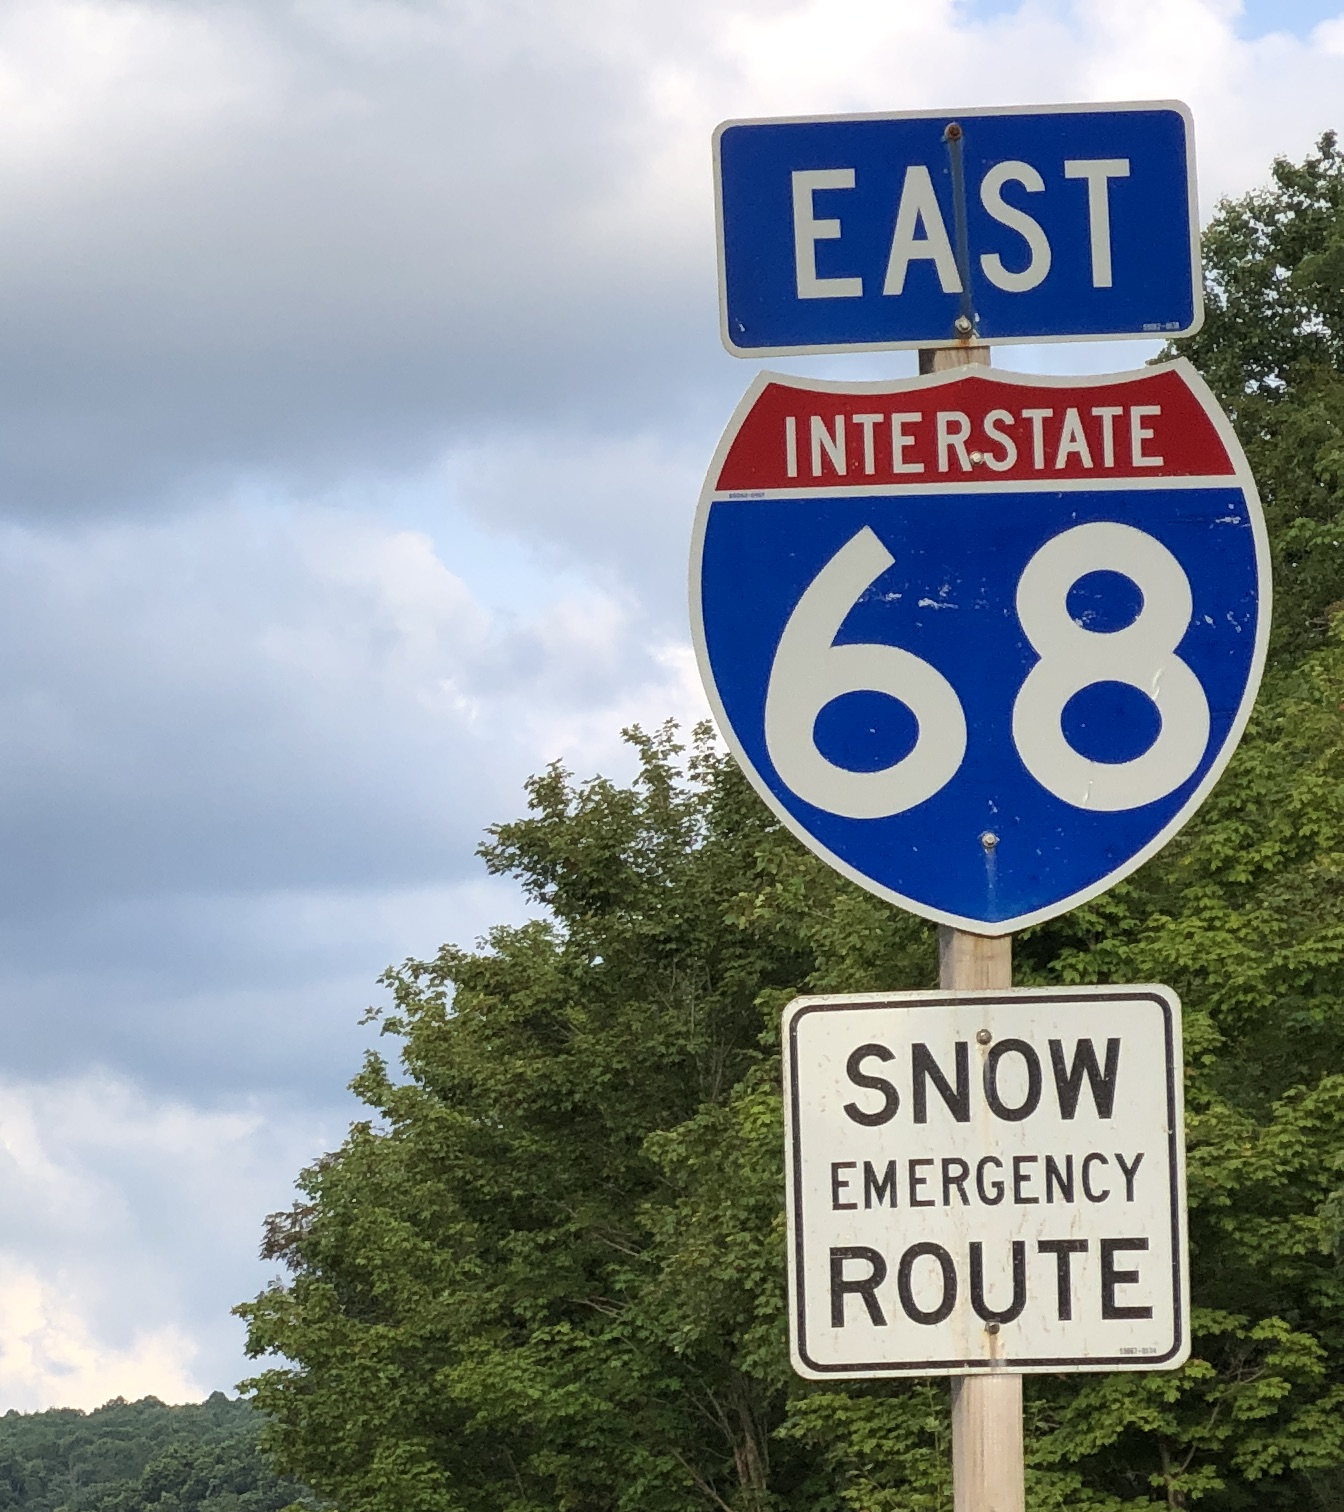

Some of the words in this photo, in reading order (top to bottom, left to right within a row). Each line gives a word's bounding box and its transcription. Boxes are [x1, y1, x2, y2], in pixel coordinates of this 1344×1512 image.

[792, 159, 1130, 299] EAST
[786, 405, 1164, 478] INTERSTATE
[764, 521, 1210, 819] 68
[843, 1037, 1122, 1127] SNOW
[831, 1152, 1144, 1211] EMERGENCY
[829, 1237, 1153, 1329] ROUTE
